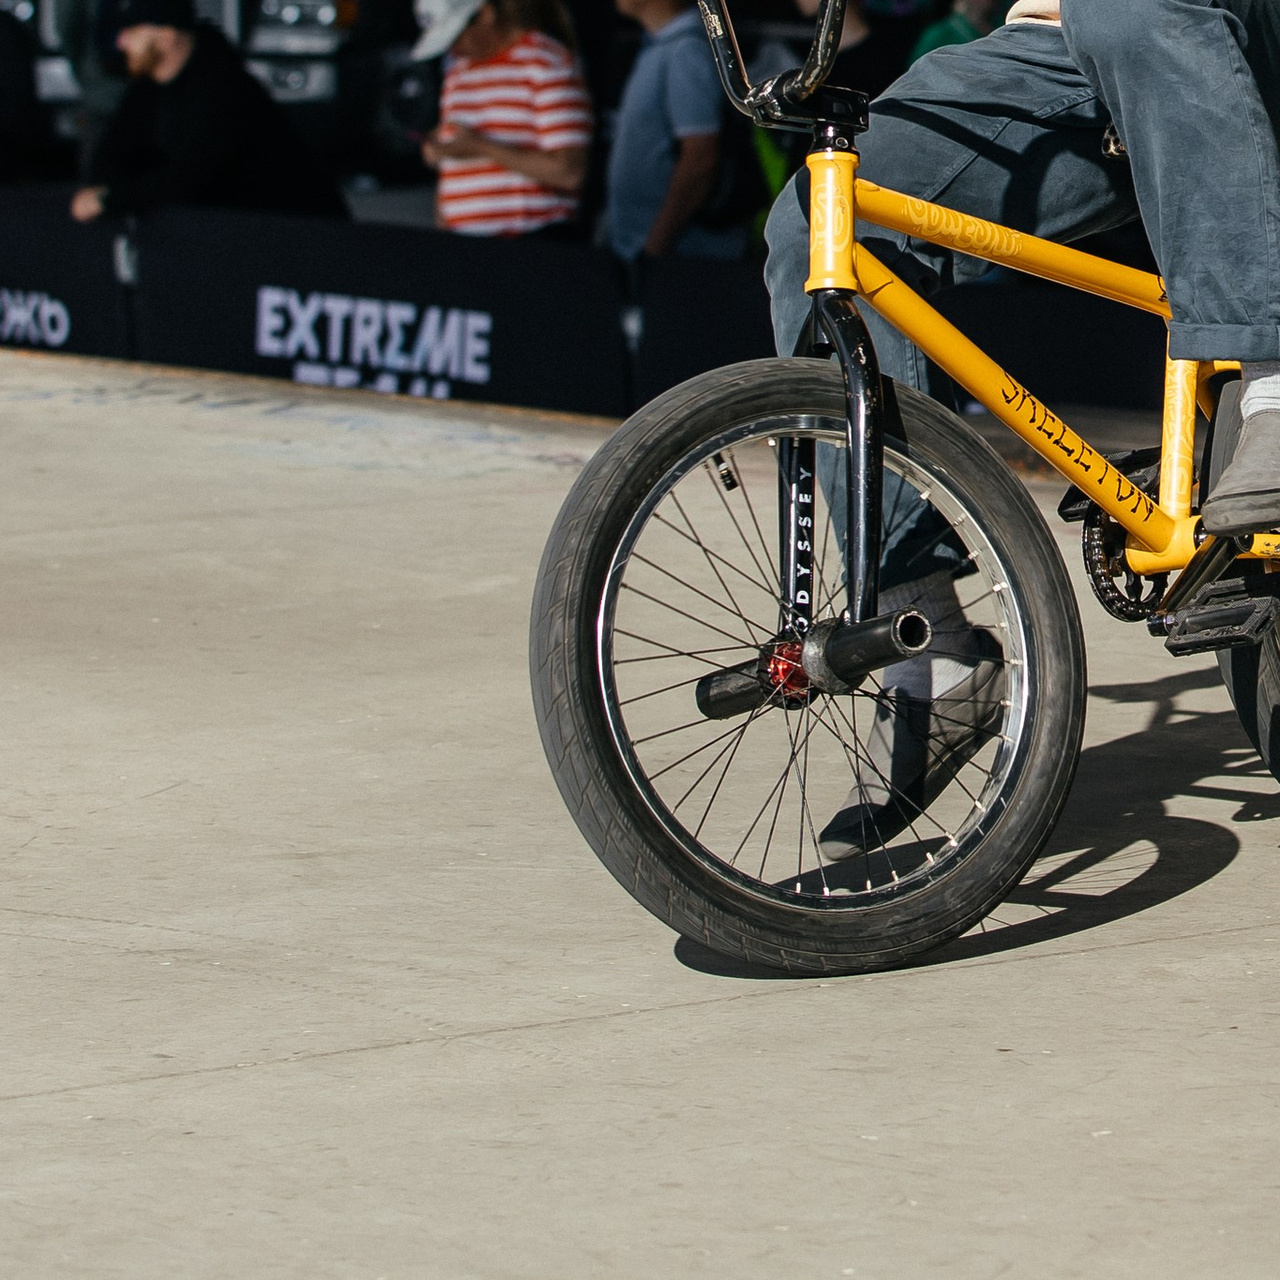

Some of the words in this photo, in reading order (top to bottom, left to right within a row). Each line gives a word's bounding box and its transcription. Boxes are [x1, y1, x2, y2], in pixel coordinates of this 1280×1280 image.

[255, 284, 493, 384] EXTREME
[1002, 372, 1155, 522] SKELETON
[796, 467, 812, 634] ODYSSEY
